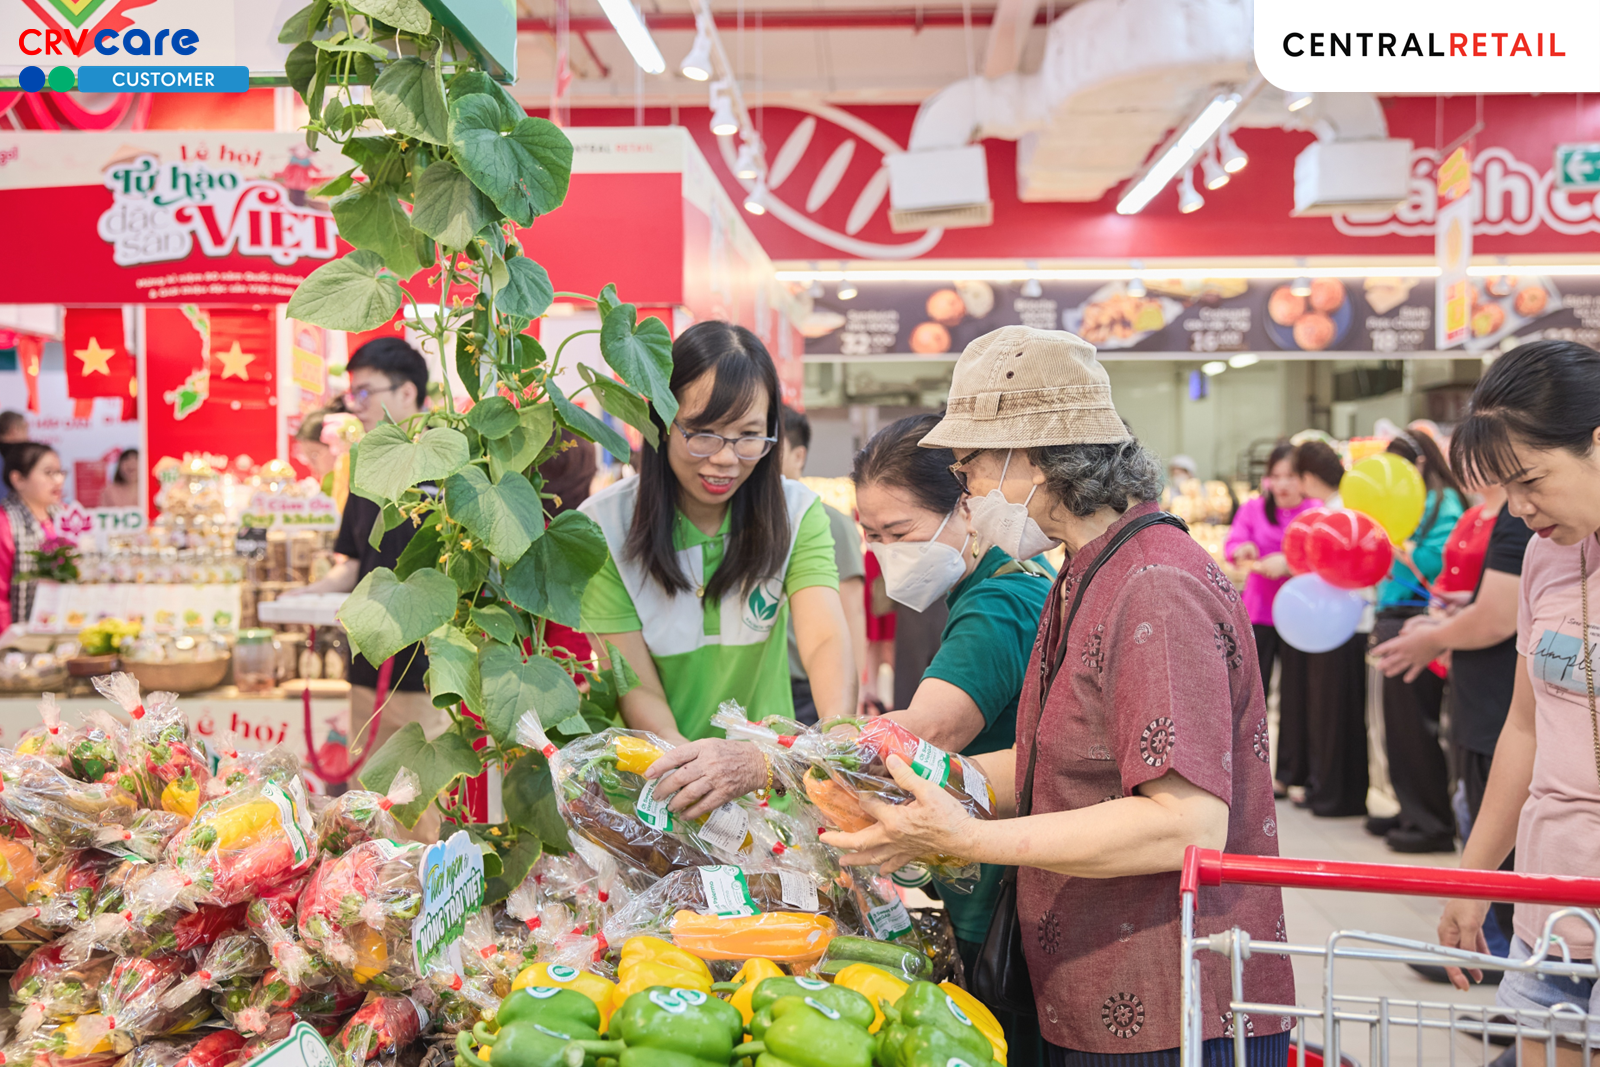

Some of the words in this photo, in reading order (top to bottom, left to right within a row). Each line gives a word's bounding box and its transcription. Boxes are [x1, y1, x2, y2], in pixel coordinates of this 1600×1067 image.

[113, 160, 160, 200] Tự
[175, 186, 338, 257] VIỆT
[420, 907, 446, 956] NÔNG
[464, 867, 482, 912] VIỆT
